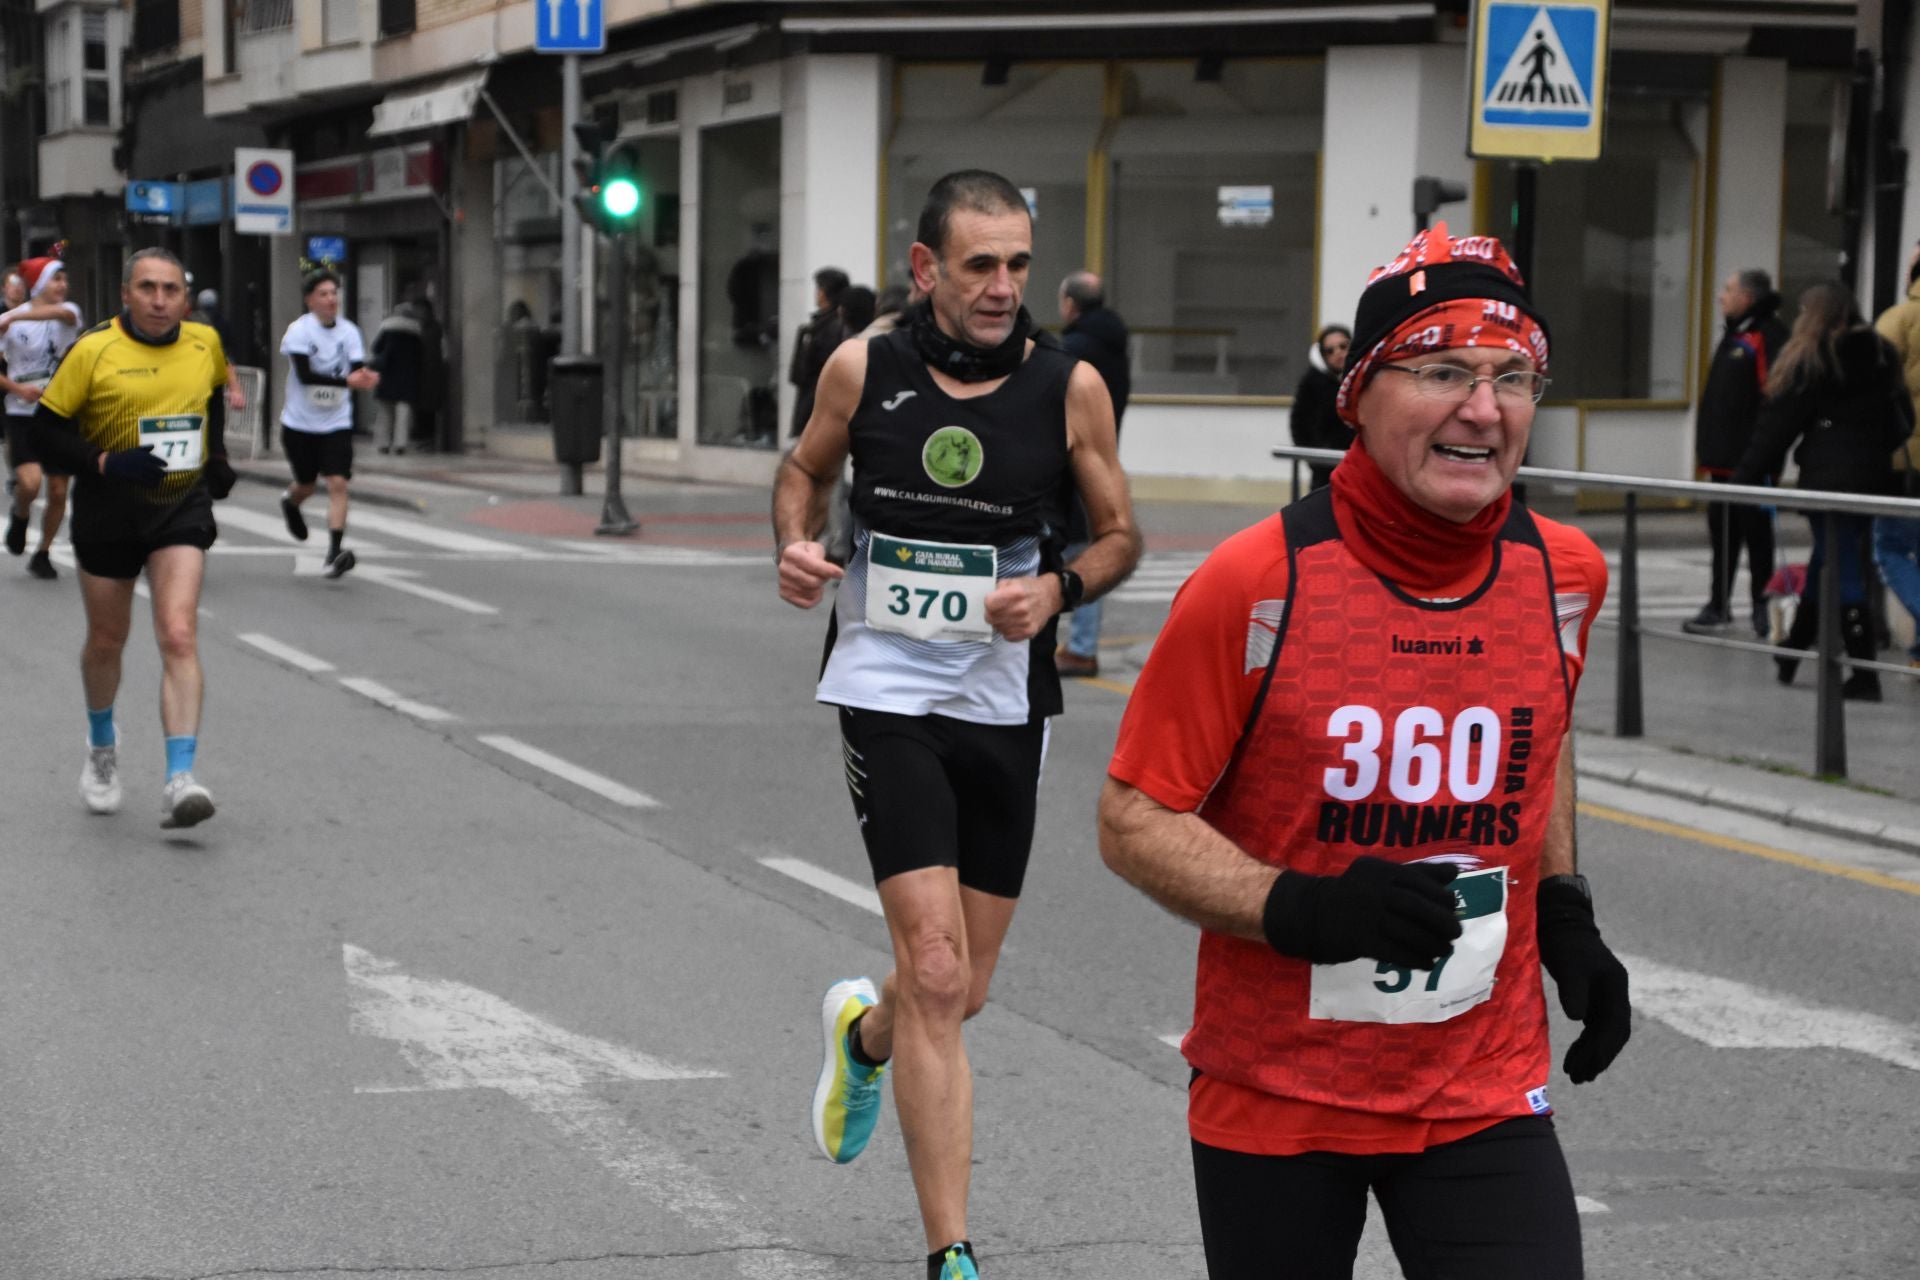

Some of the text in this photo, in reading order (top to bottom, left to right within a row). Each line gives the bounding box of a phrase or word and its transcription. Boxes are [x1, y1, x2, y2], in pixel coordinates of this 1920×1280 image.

[161, 440, 189, 458] 77
[874, 486, 1013, 515] WWW.CALAGURRISATLETICO.ES
[928, 558, 964, 569] NAVARRA
[935, 552, 961, 561] RURAL
[888, 584, 967, 622] 370
[1392, 635, 1462, 655] luanvi
[1504, 707, 1534, 795] RIOJA
[1316, 801, 1521, 848] RUNNERS
[1373, 946, 1455, 994] 57
